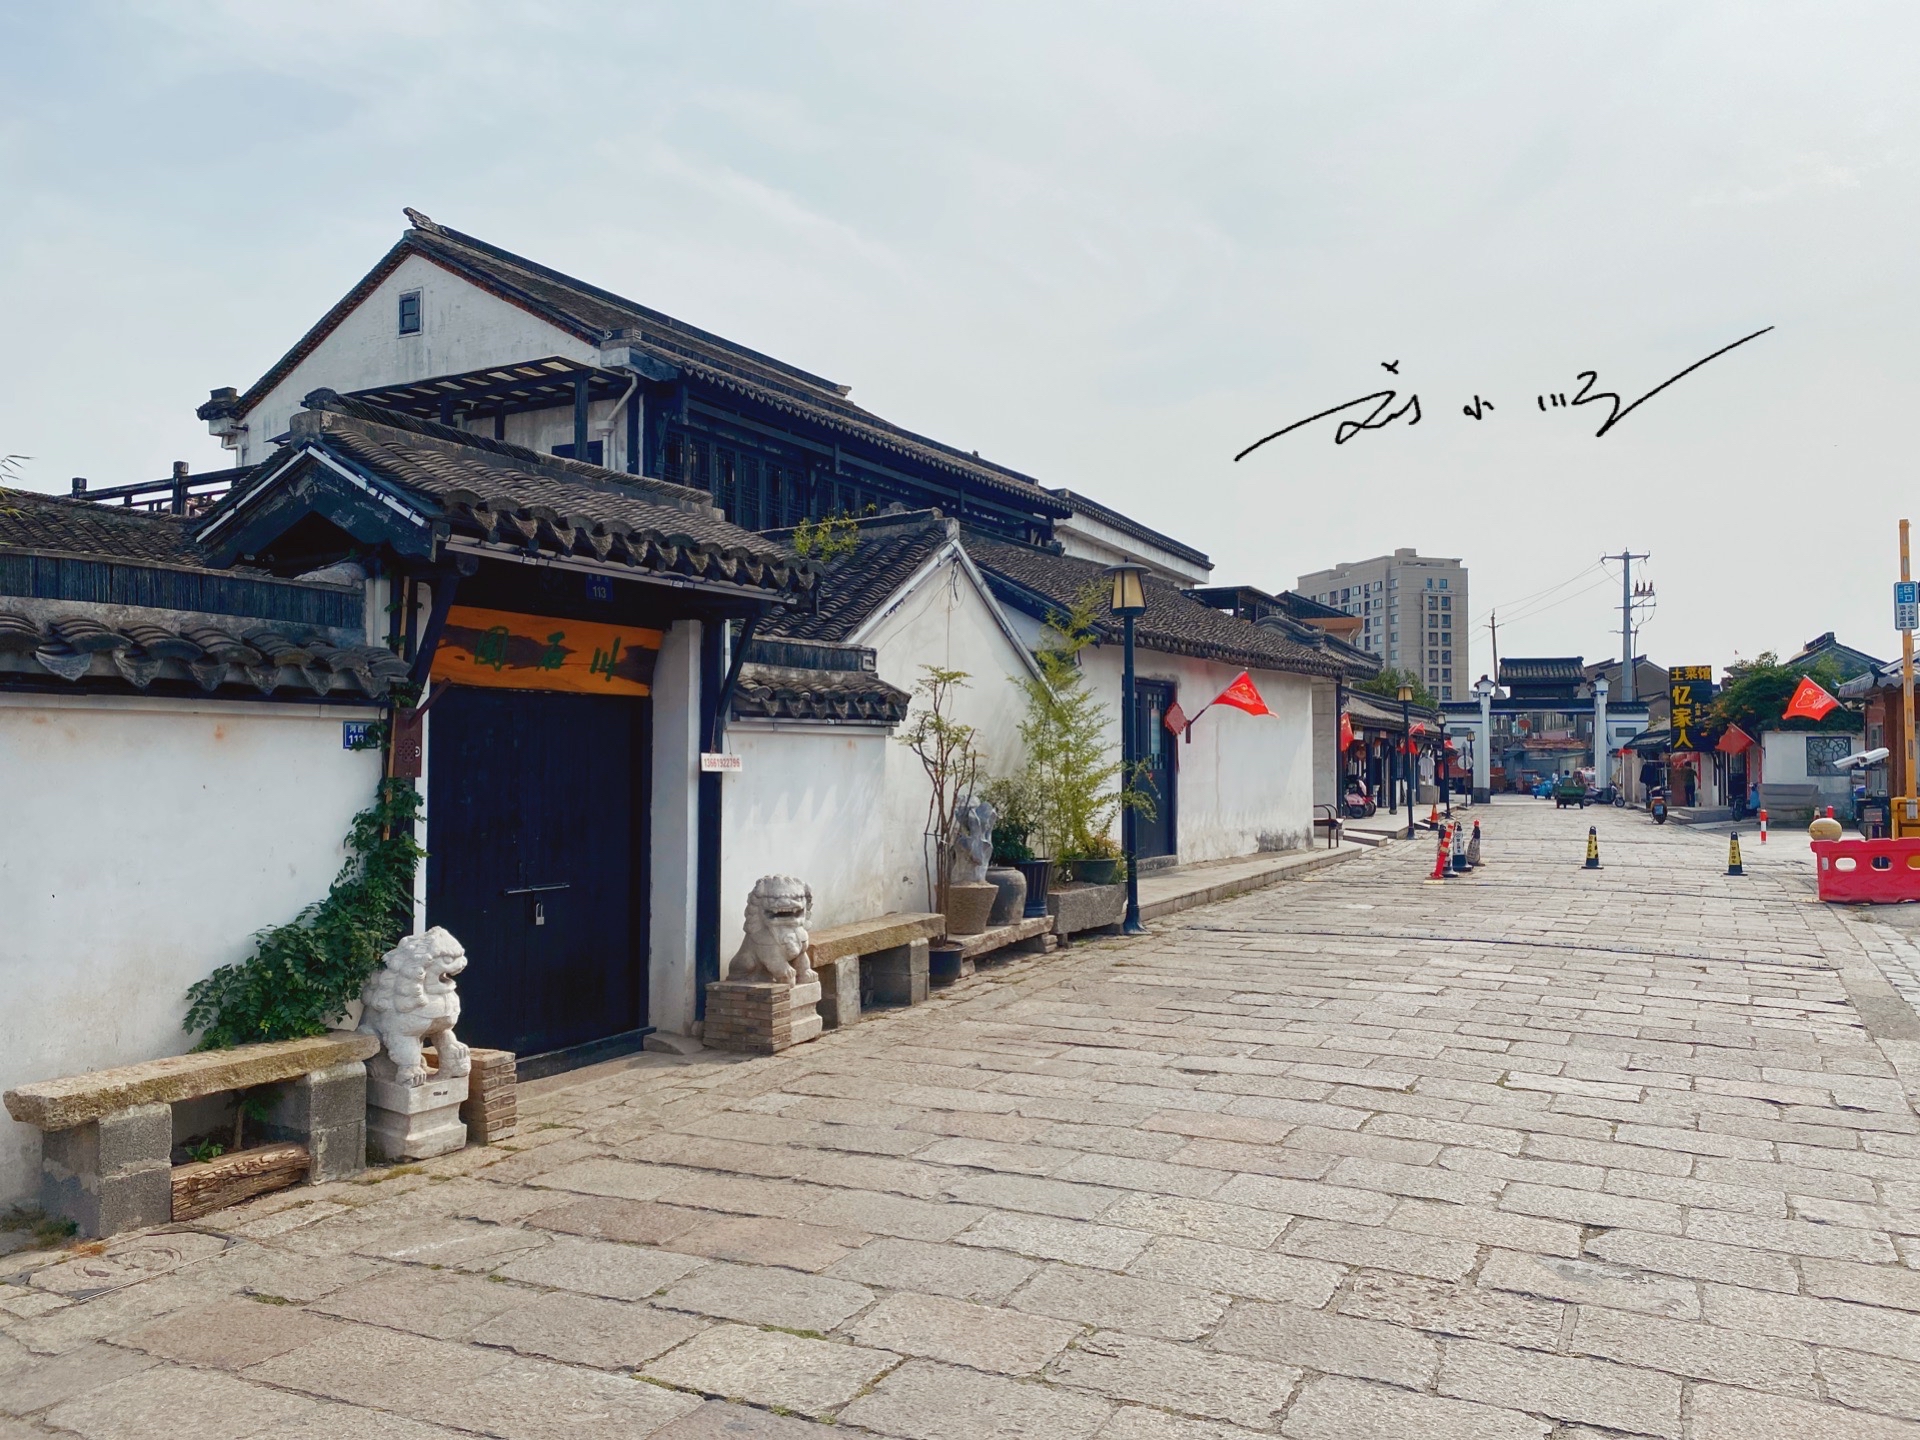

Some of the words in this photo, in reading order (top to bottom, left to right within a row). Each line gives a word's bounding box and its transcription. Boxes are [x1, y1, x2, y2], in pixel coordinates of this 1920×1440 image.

[592, 586, 607, 599] 113
[1904, 586, 1913, 601] 出口
[1671, 666, 1711, 681] 土菜馆
[1672, 685, 1694, 749] 忆家人
